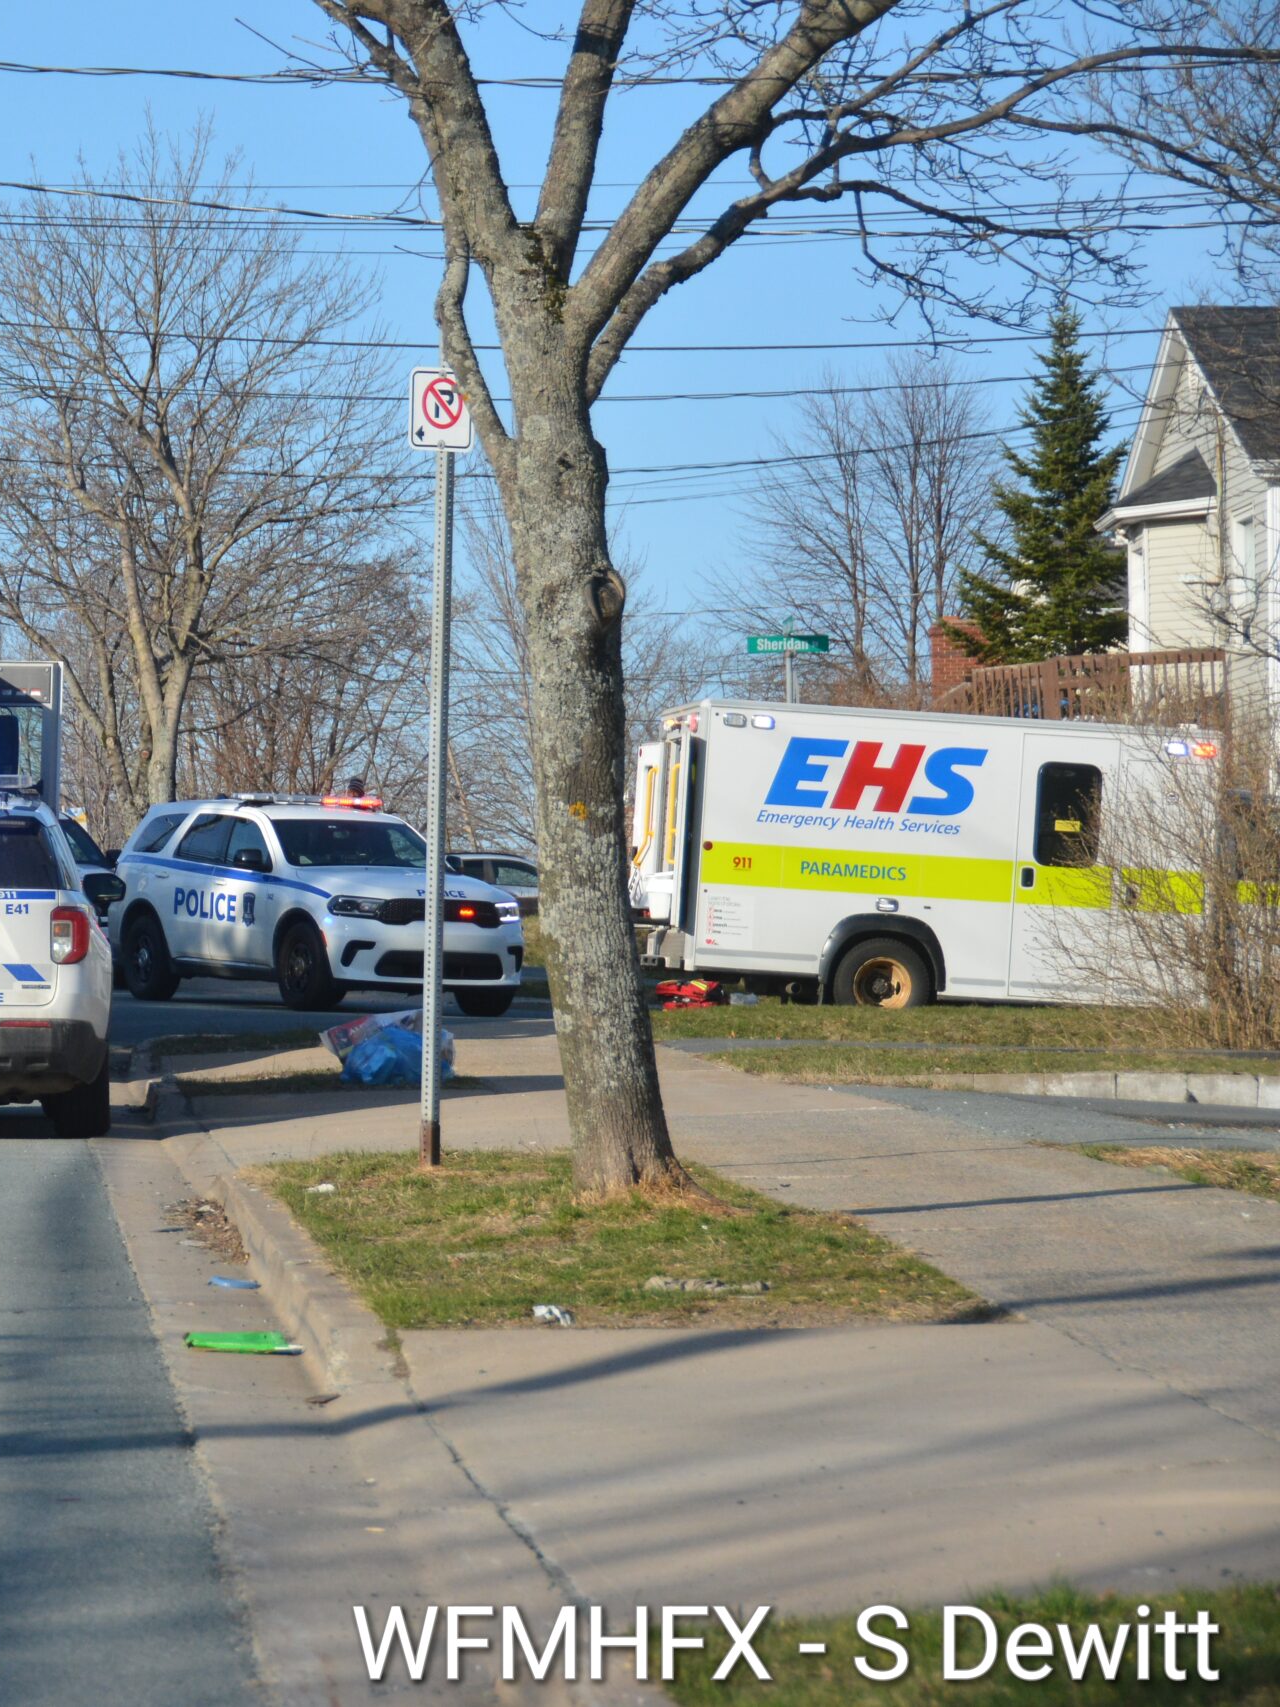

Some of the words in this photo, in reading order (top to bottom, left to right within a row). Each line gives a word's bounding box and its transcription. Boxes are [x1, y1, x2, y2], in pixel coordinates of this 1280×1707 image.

[757, 637, 809, 651] Sheridan
[764, 737, 988, 817] EHS
[756, 809, 840, 830] Emergency
[844, 815, 894, 832] Health
[899, 818, 961, 836] Services
[732, 856, 753, 870] 911
[800, 860, 907, 881] PARAMEDICS
[416, 889, 467, 899] PICE
[5, 903, 30, 915] E41
[173, 887, 237, 923] POLICE
